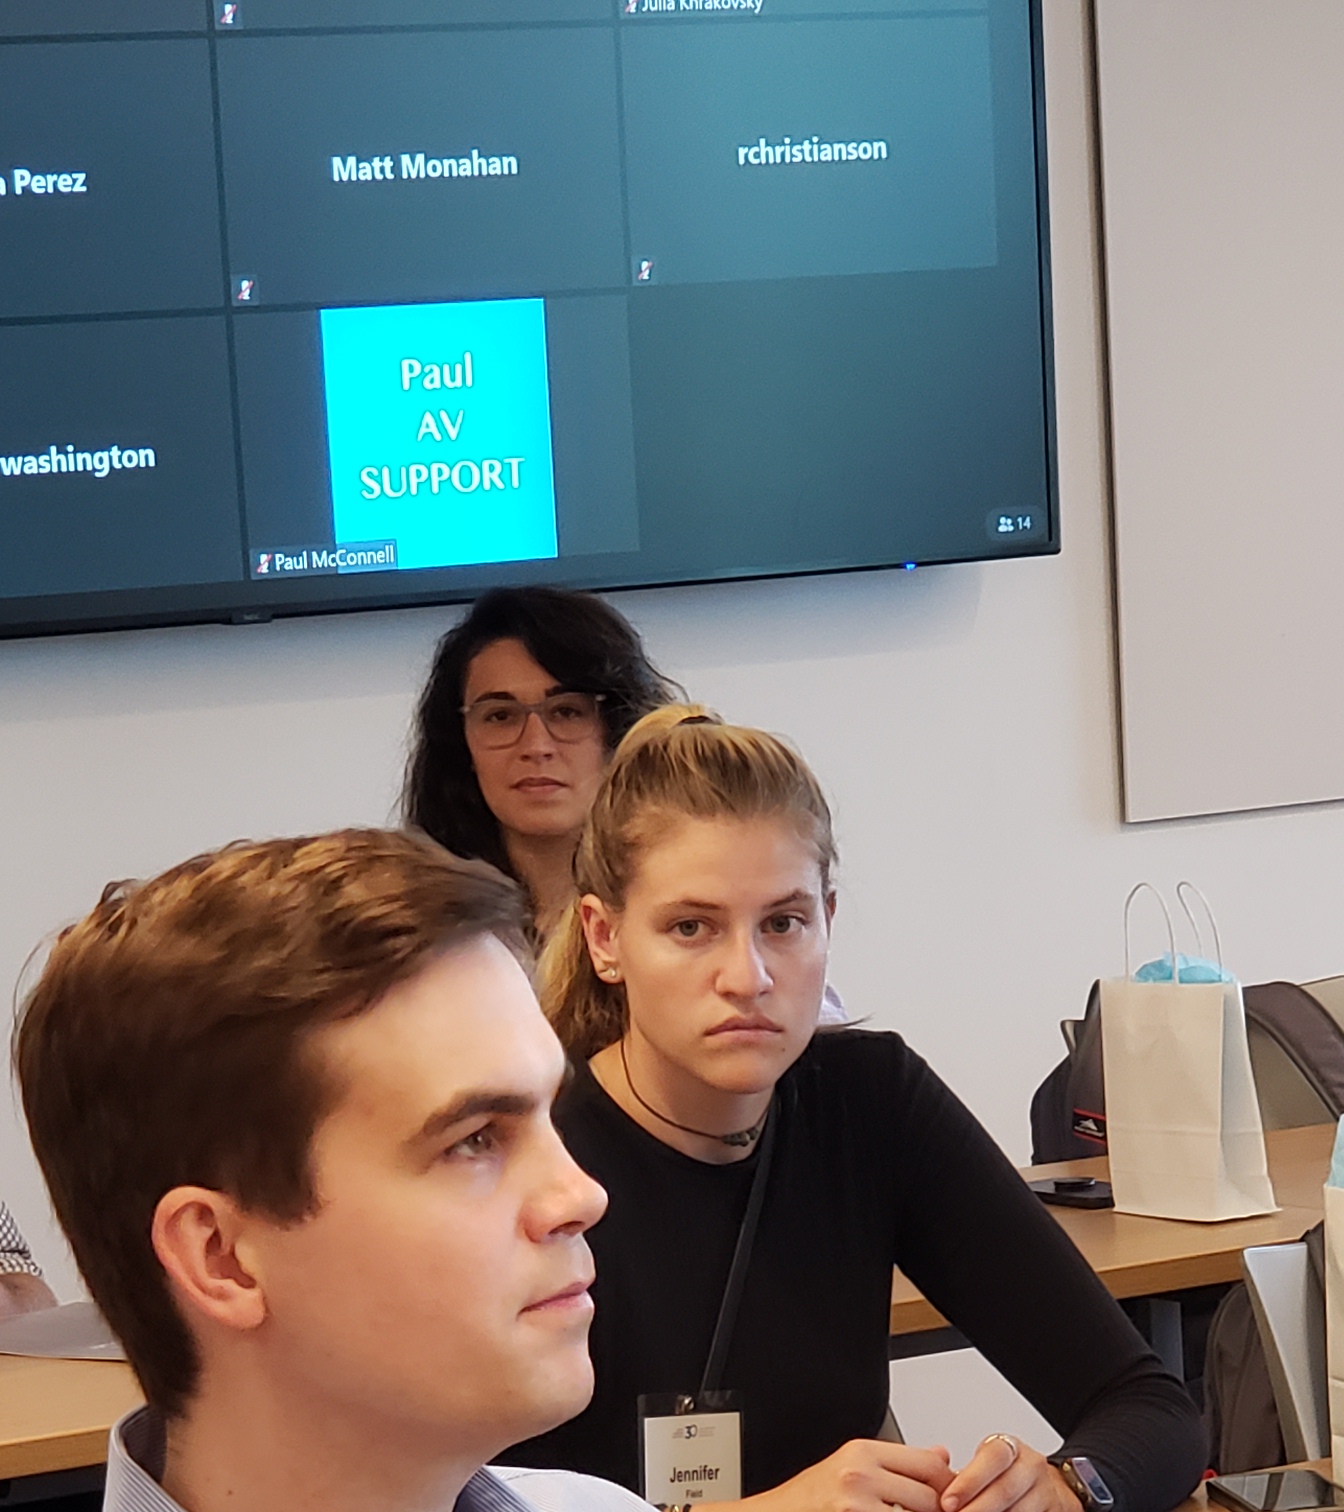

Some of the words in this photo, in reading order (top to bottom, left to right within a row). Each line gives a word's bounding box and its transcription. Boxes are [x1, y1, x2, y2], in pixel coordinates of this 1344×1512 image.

[737, 135, 888, 165] rchristianson
[331, 155, 395, 181] Matt
[400, 148, 519, 179] Monahan
[13, 168, 88, 195] Perez
[400, 350, 474, 391] Paul
[416, 409, 465, 442] AV
[359, 457, 526, 500] SUPPORT
[1016, 515, 1032, 530] 14
[273, 551, 308, 571] Paul
[311, 544, 395, 568] McConnell
[684, 1424, 698, 1439] 30
[669, 1464, 720, 1483] Jennifer
